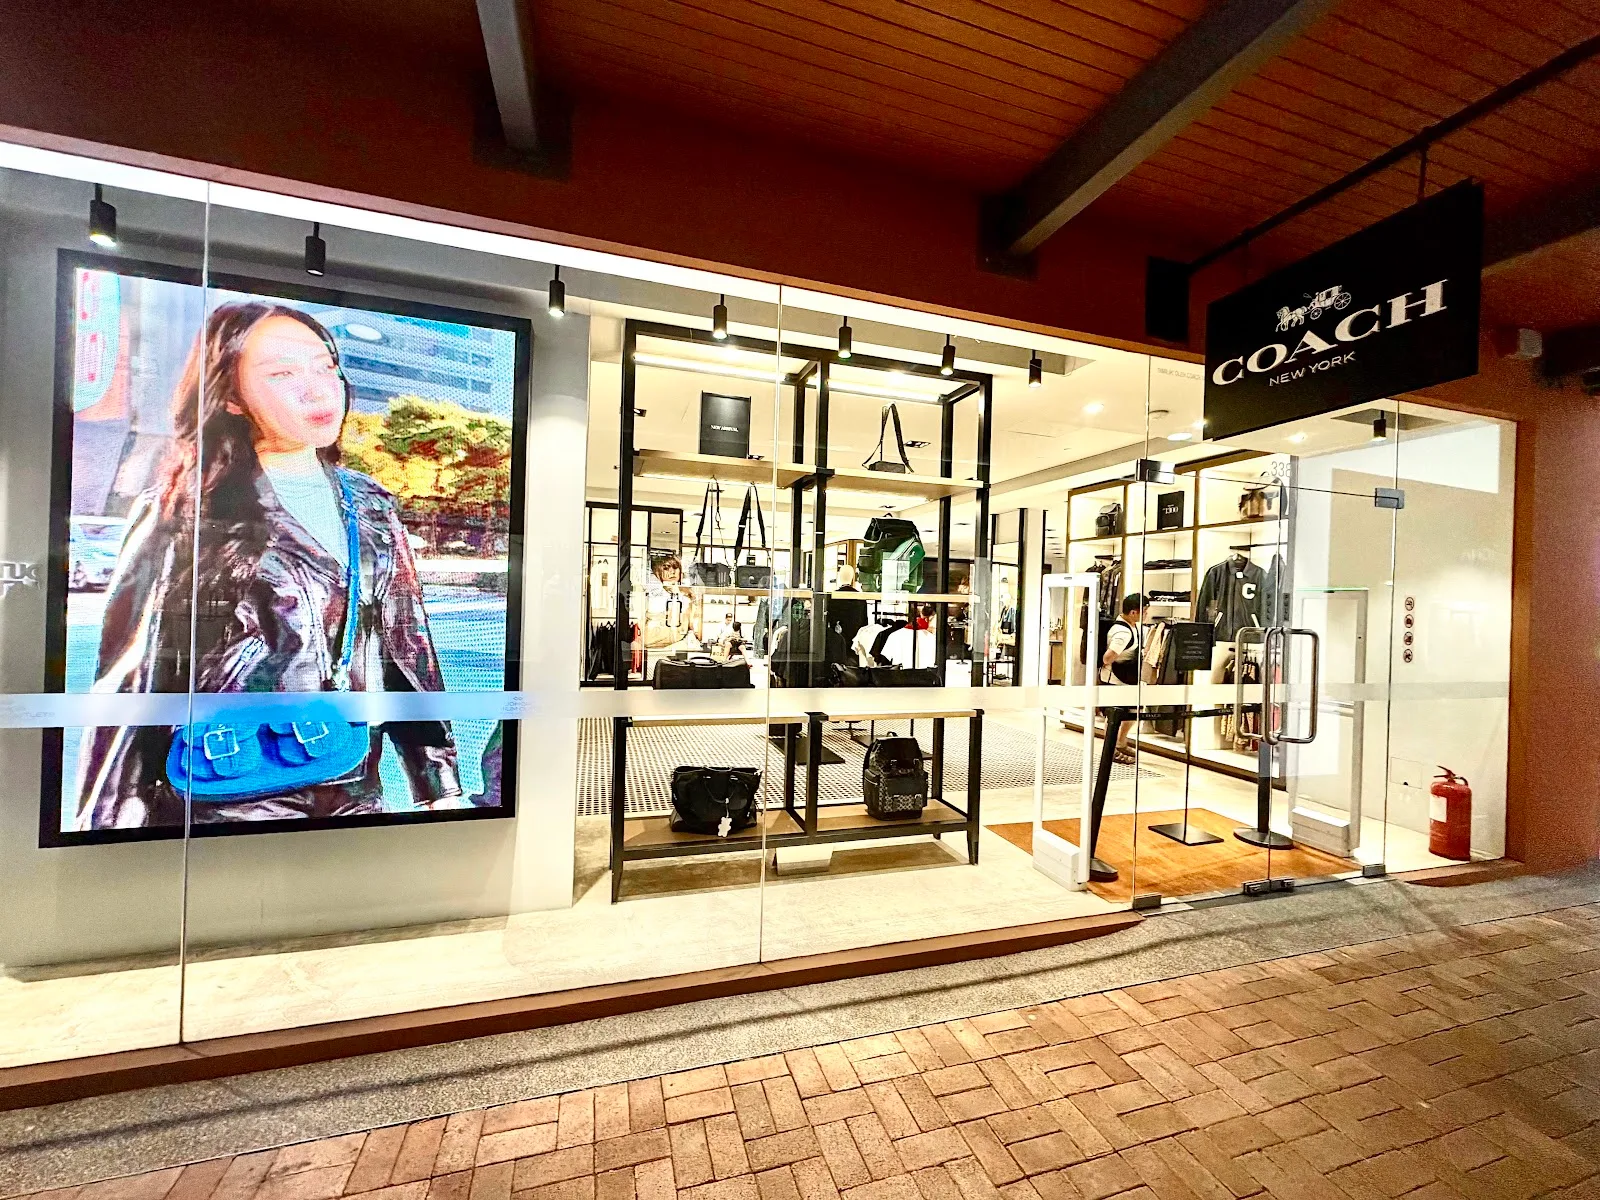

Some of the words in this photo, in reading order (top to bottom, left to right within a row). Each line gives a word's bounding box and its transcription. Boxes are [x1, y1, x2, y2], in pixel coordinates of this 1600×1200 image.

[1212, 279, 1448, 386] COACH
[1269, 367, 1306, 387] NEW
[1308, 351, 1357, 374] YORK
[1242, 583, 1256, 599] C
